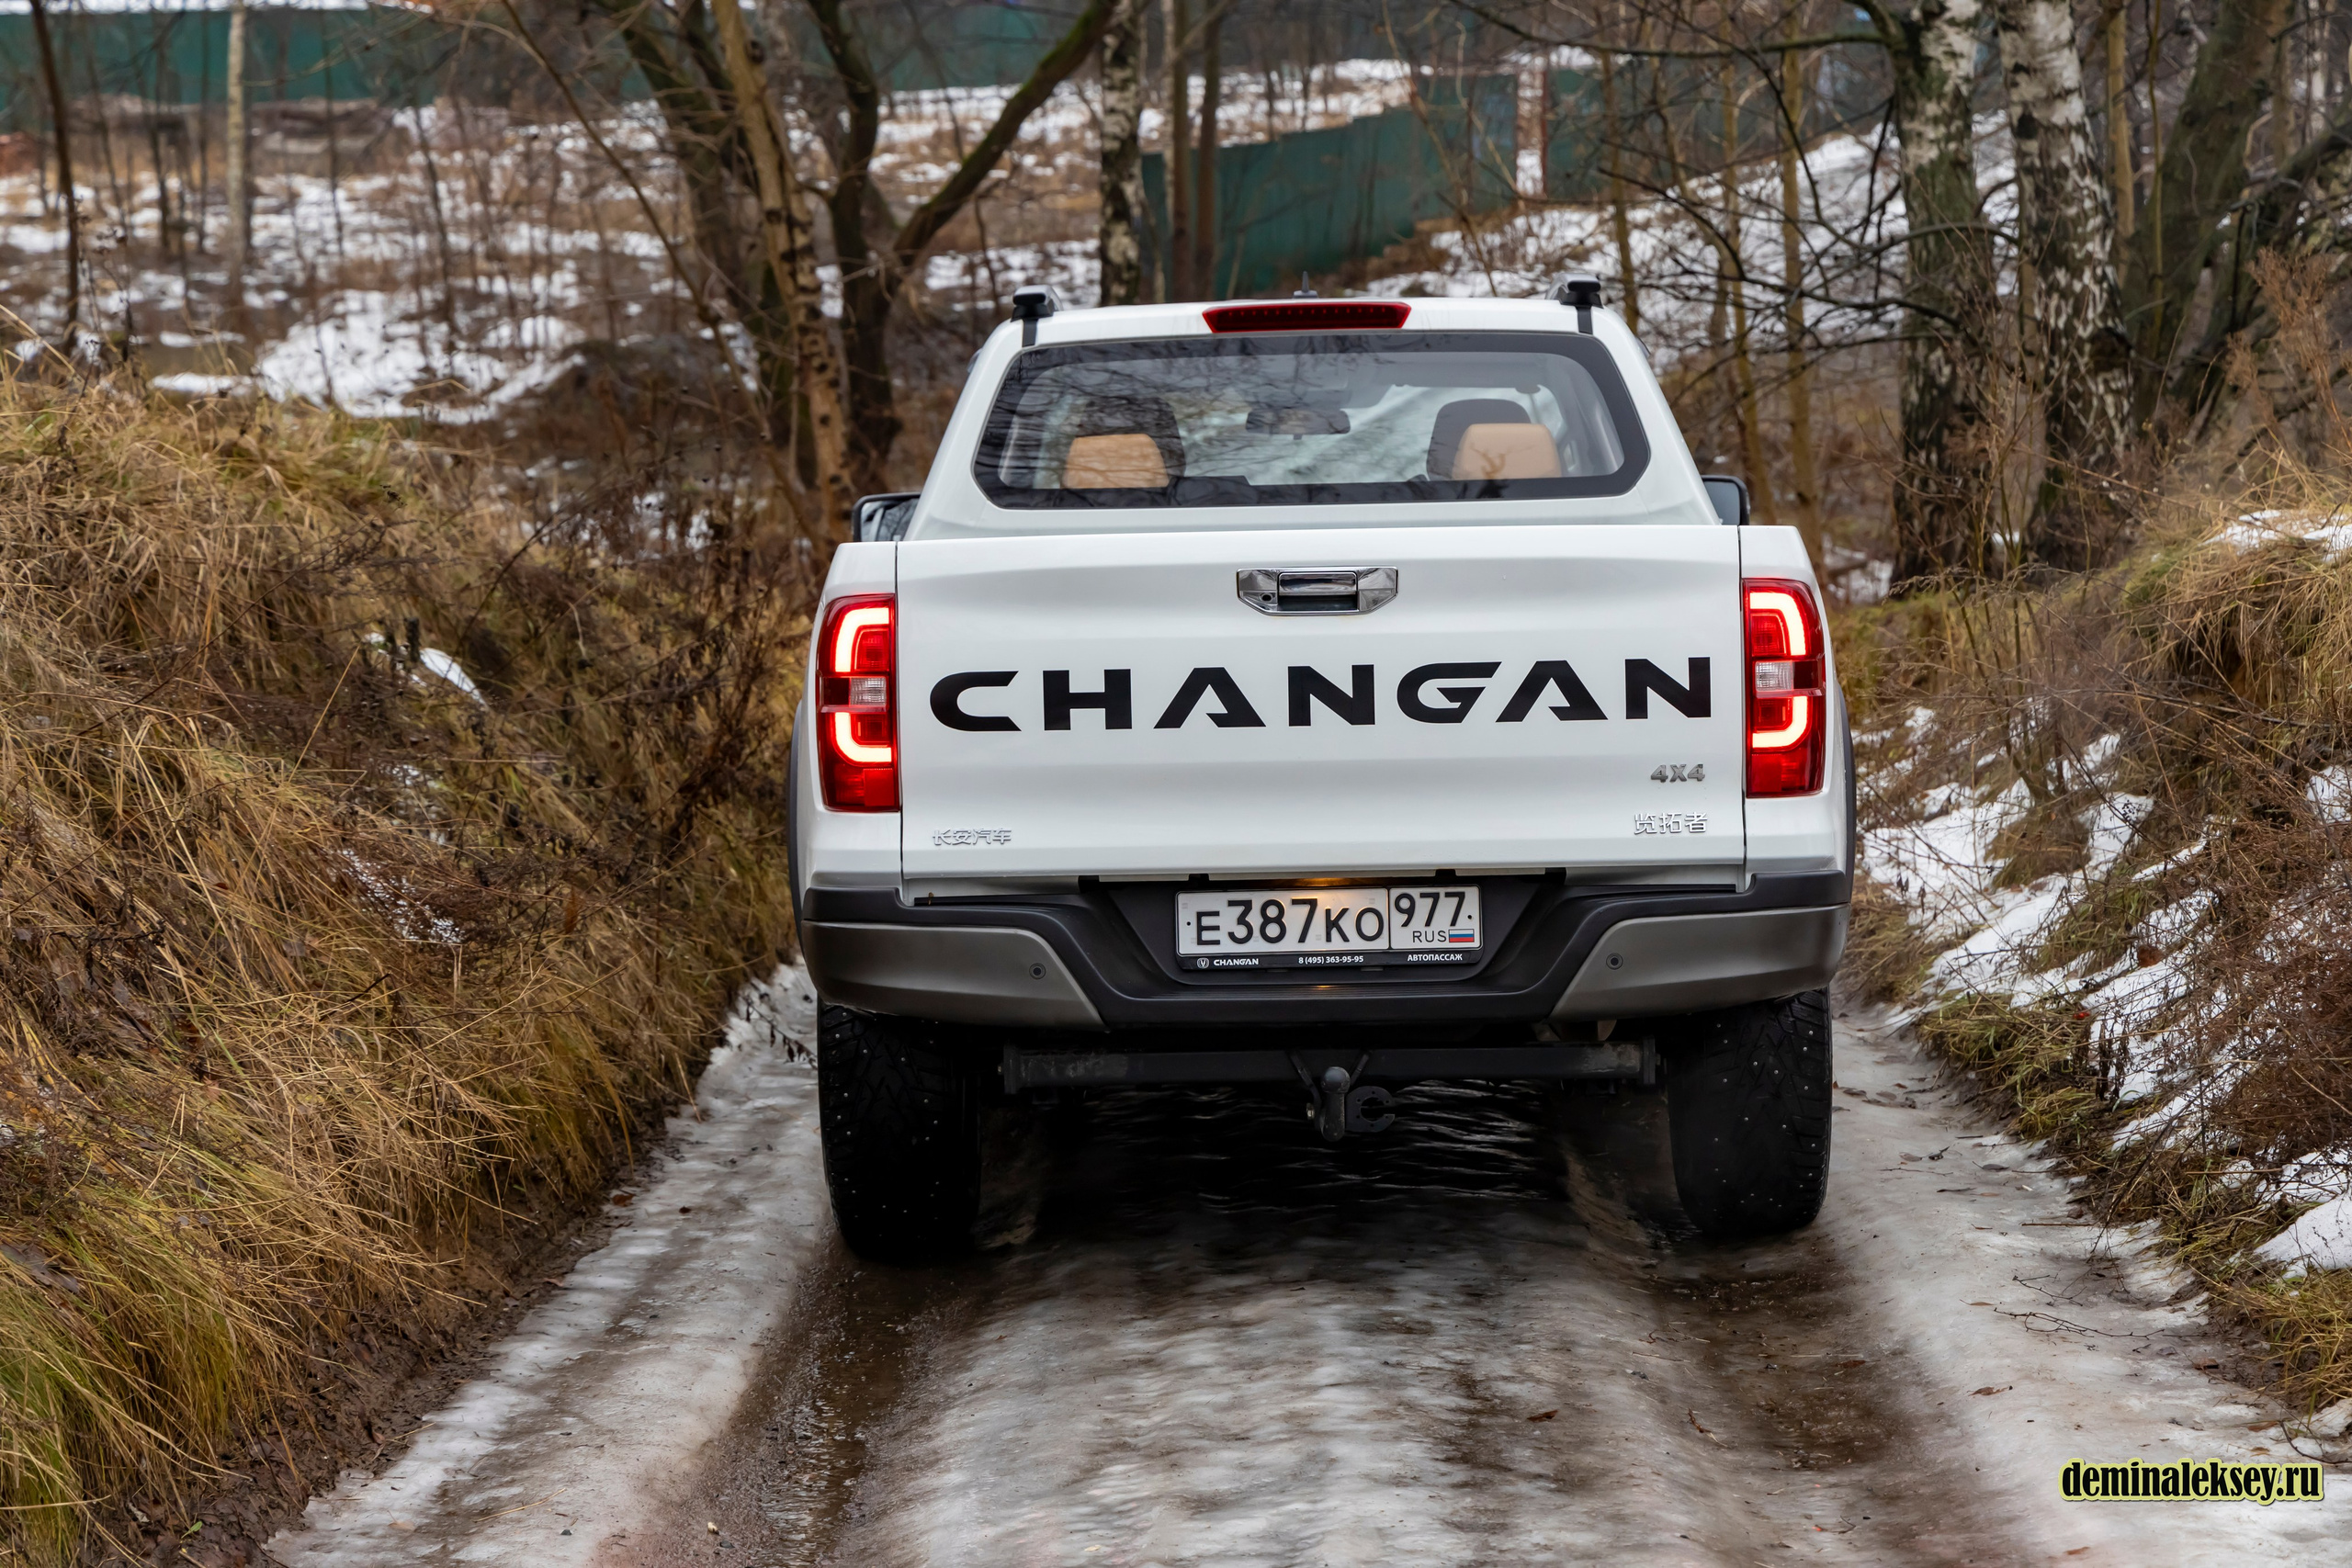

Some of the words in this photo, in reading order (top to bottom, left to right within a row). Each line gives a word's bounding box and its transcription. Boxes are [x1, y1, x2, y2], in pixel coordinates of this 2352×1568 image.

[930, 657, 1712, 733] CHANGAN
[1650, 763, 1706, 783] 4X4
[1634, 812, 1708, 835] 览拓者
[933, 828, 1012, 845] 长安汽车
[1394, 891, 1466, 927] 977
[1412, 931, 1447, 943] RUS
[1213, 957, 1259, 966] CHANGAN
[1298, 956, 1304, 964] 8
[1306, 956, 1325, 965] (495)
[1325, 955, 1364, 964] 363-95-95
[1407, 953, 1464, 963] АВТОПАССАЖ
